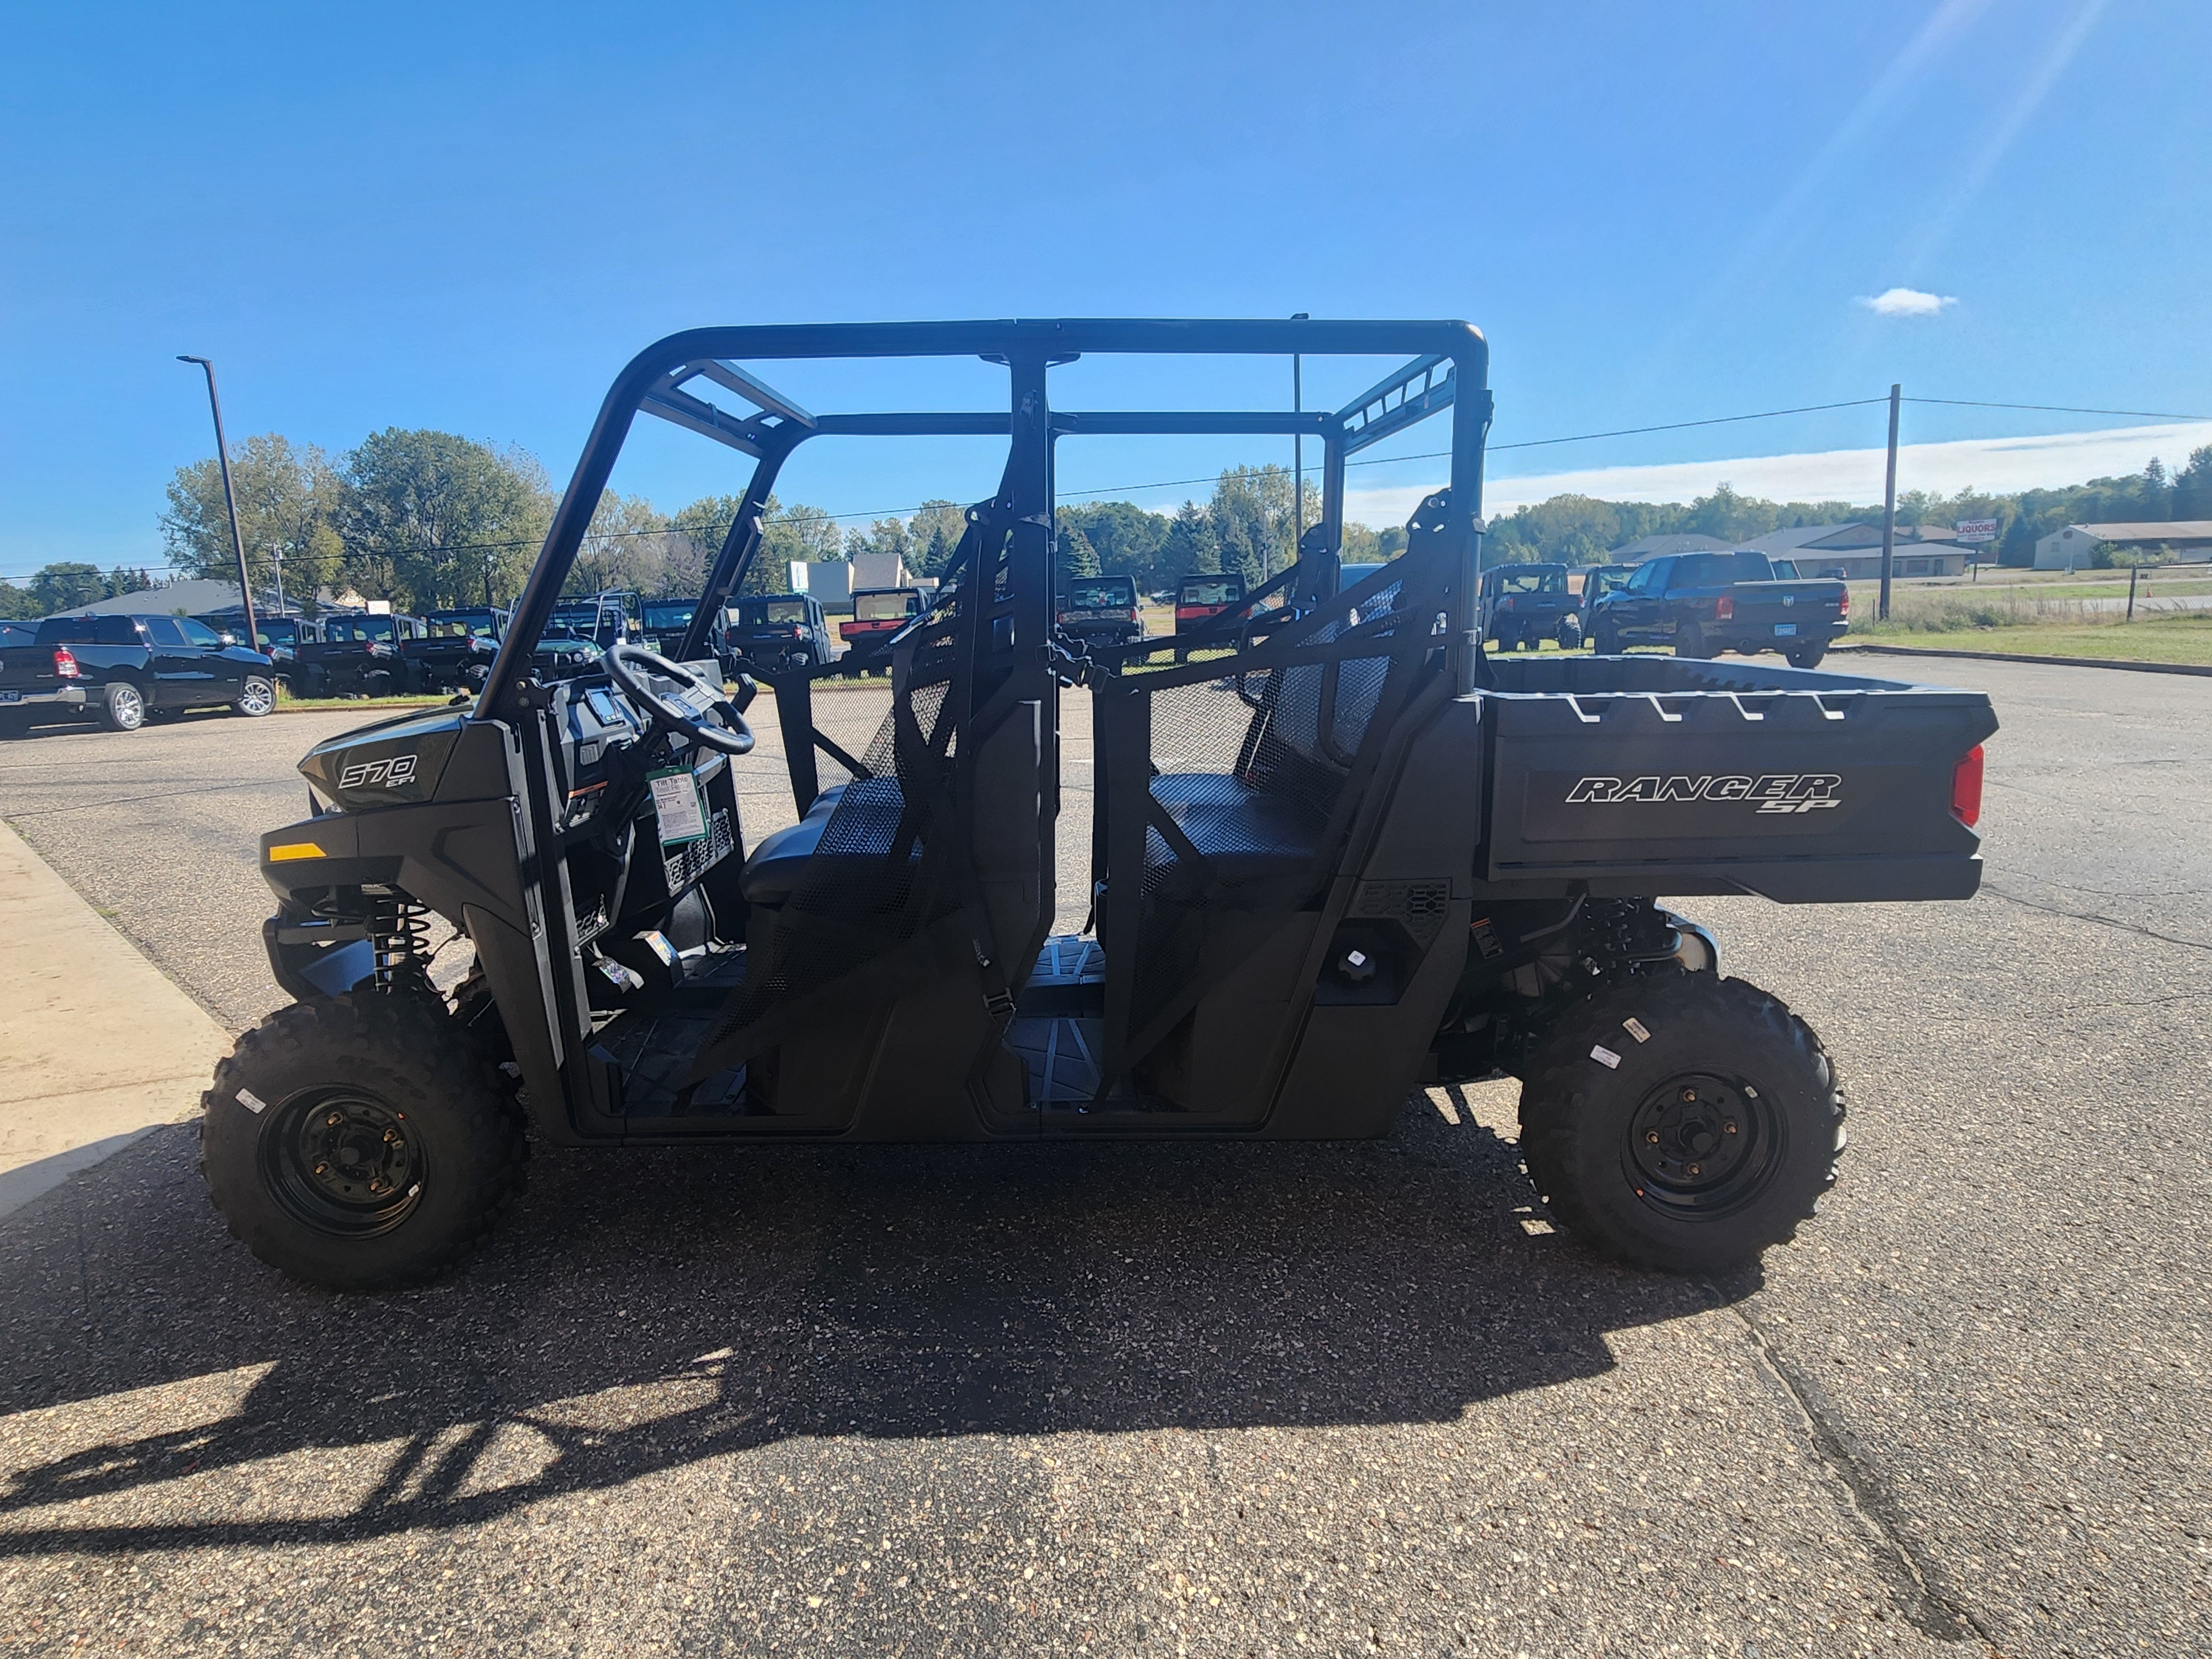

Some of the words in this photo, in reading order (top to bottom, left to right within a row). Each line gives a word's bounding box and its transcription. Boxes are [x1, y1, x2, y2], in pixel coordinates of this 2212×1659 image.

[1958, 523, 1996, 534] LIQUORS
[338, 754, 418, 789] 570
[385, 775, 415, 787] EFI
[669, 776, 688, 784] Table
[1565, 774, 1842, 802] RANGER
[1755, 800, 1842, 813] SP
